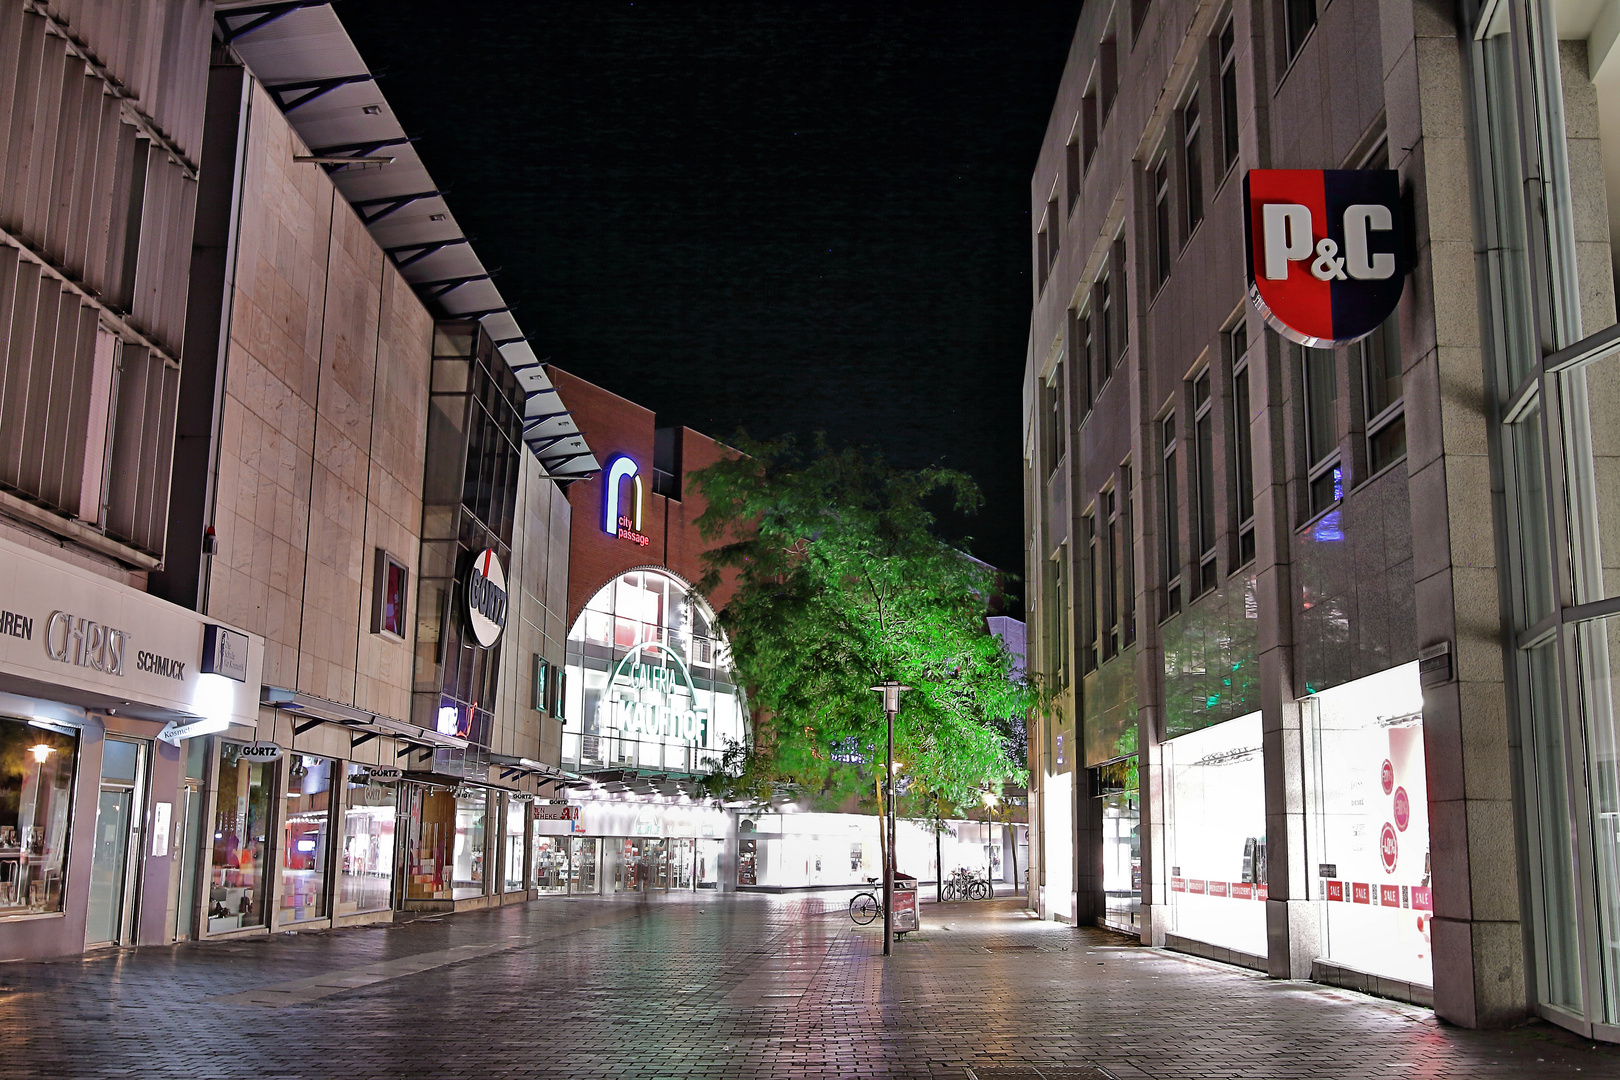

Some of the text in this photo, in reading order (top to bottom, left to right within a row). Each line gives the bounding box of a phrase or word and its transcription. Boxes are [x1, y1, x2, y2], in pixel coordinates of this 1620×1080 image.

[1263, 203, 1396, 281] P&C
[618, 515, 633, 530] city
[618, 528, 650, 547] passage
[45, 610, 132, 676] CHRIST
[137, 650, 186, 681] SCHMUCK
[630, 661, 677, 695] GALERIA
[1329, 886, 1341, 897] SALE
[1355, 888, 1367, 899] SALE
[1383, 890, 1396, 902] SALE
[1415, 892, 1429, 905] SALE
